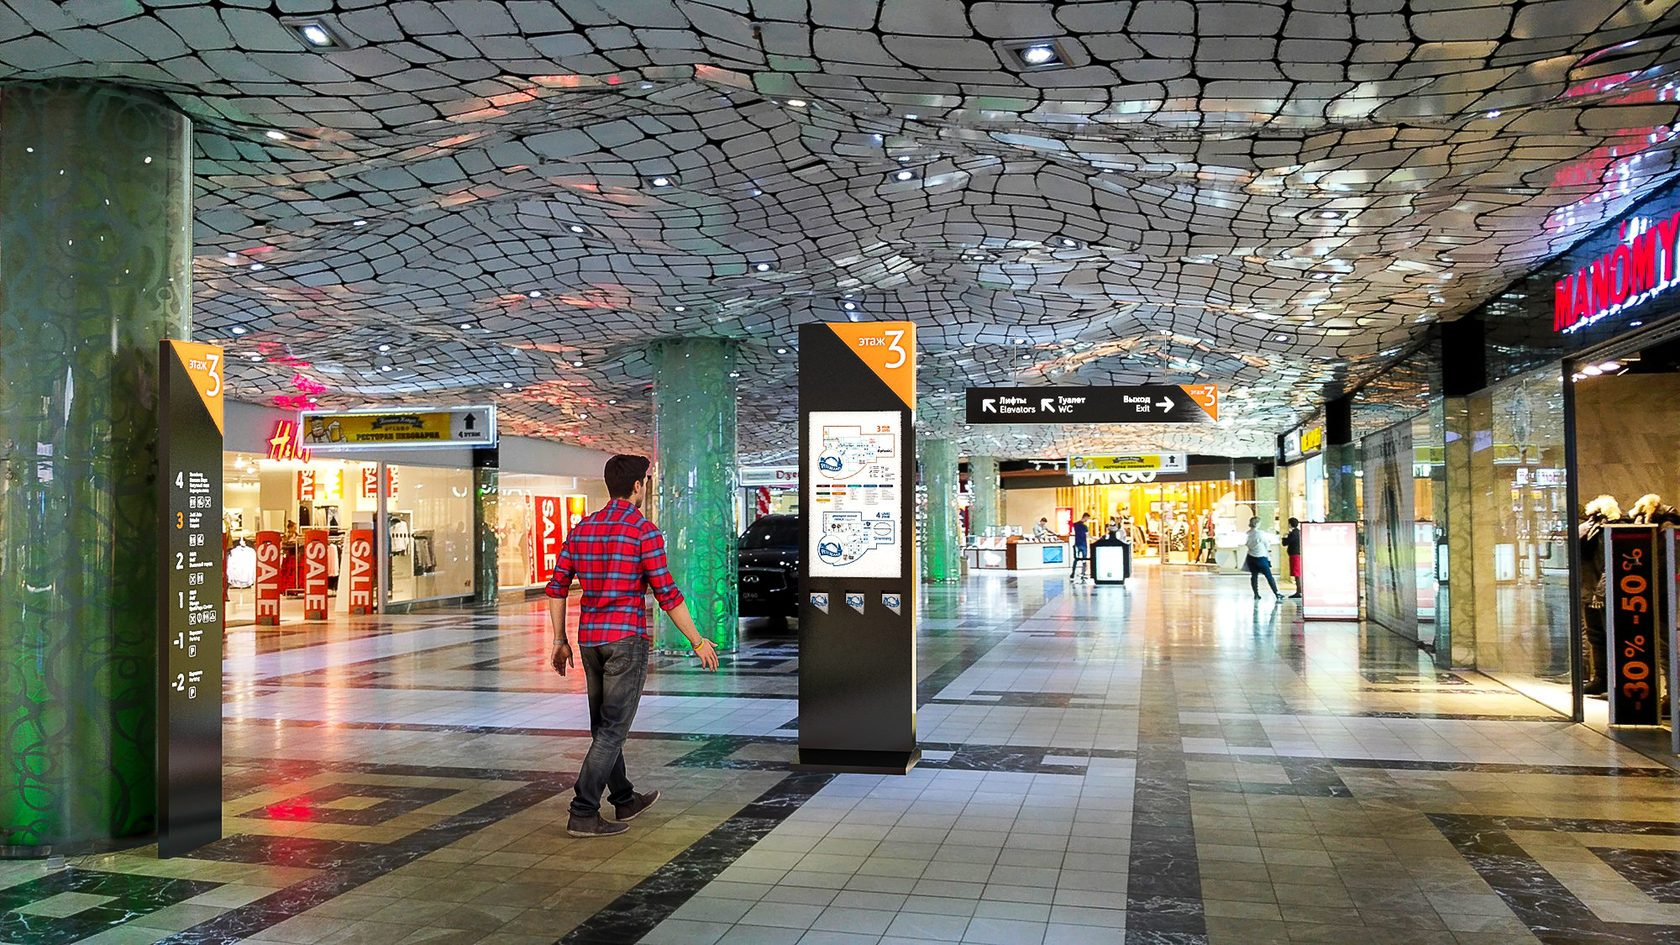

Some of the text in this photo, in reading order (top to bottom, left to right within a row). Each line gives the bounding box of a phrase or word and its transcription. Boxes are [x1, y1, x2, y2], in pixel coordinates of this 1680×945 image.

[859, 330, 906, 369] этаж 3
[189, 354, 220, 397] этаж 3
[999, 396, 1027, 406] Лифты
[1058, 396, 1086, 405] Туалет
[1123, 395, 1151, 404] Выход
[1204, 386, 1216, 406] 3
[1000, 406, 1036, 414] Elevators
[1058, 405, 1074, 414] WC
[175, 471, 184, 489] 4
[301, 470, 313, 501] SALE
[176, 511, 184, 529] 3
[542, 499, 557, 571] SALE
[175, 552, 184, 570] 2
[257, 543, 279, 616] SALE
[305, 542, 326, 611] SALE
[351, 541, 371, 606] SALE
[178, 591, 184, 609] 1
[1620, 548, 1650, 710] -30% -50%
[173, 632, 184, 649] -1
[171, 673, 185, 691] -2
